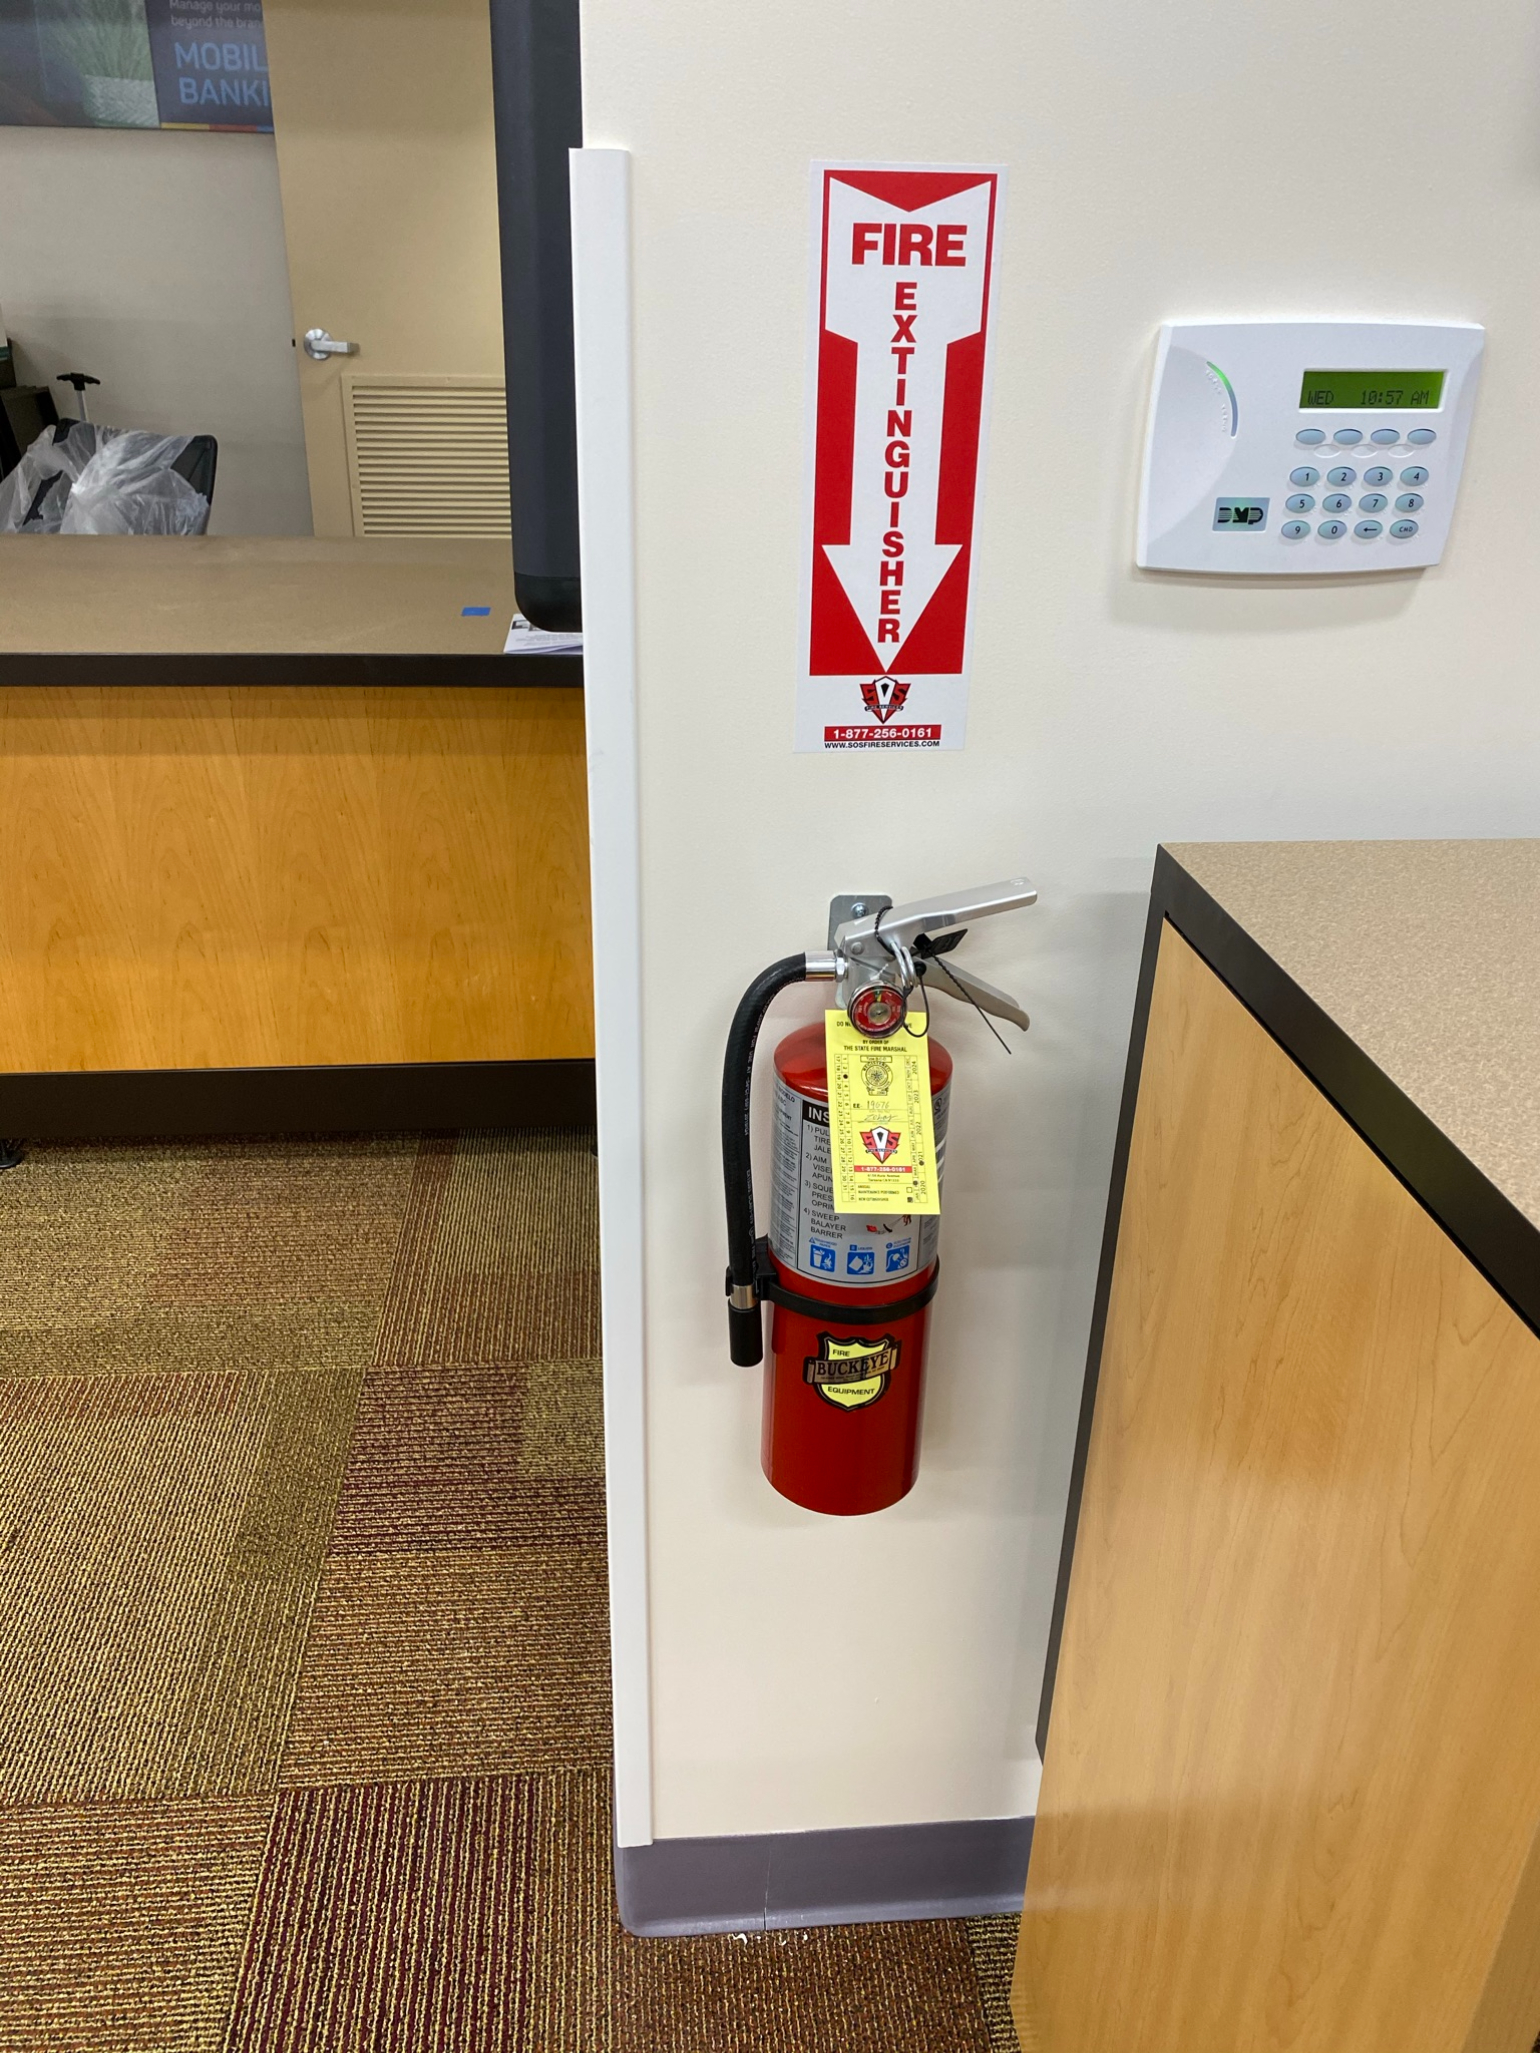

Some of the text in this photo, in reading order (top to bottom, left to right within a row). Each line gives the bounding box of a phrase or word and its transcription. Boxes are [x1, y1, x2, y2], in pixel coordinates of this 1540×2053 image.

[169, 0, 213, 13] Manage
[216, 2, 241, 14] your
[170, 15, 212, 30] beyond
[215, 17, 233, 28] the
[174, 42, 268, 72] MOBIL
[178, 77, 270, 107] BANKI
[851, 223, 968, 267] FIRE
[1307, 390, 1430, 405] WED 10:57 AM
[878, 282, 918, 644] EXTINGUISHER
[1305, 472, 1420, 482] 1 2 3 4
[1300, 498, 1414, 508] 5 6 7 8
[1218, 507, 1264, 524] DMP
[1295, 526, 1300, 534] 9
[1332, 526, 1338, 534] 0
[834, 728, 932, 739] 1-877-256-0161
[824, 740, 940, 749] WWW.SOSFIRESERVICES.COM
[808, 1106, 830, 1123] INS
[813, 1156, 827, 1164] AIM
[804, 1180, 811, 1188] 3)
[804, 1207, 839, 1221] 4) SWEEP
[811, 1218, 846, 1232] BALAYER
[811, 1226, 843, 1239] BARRER
[816, 1351, 889, 1376] BUCKEYE
[827, 1386, 875, 1395] EQUIPMENT
